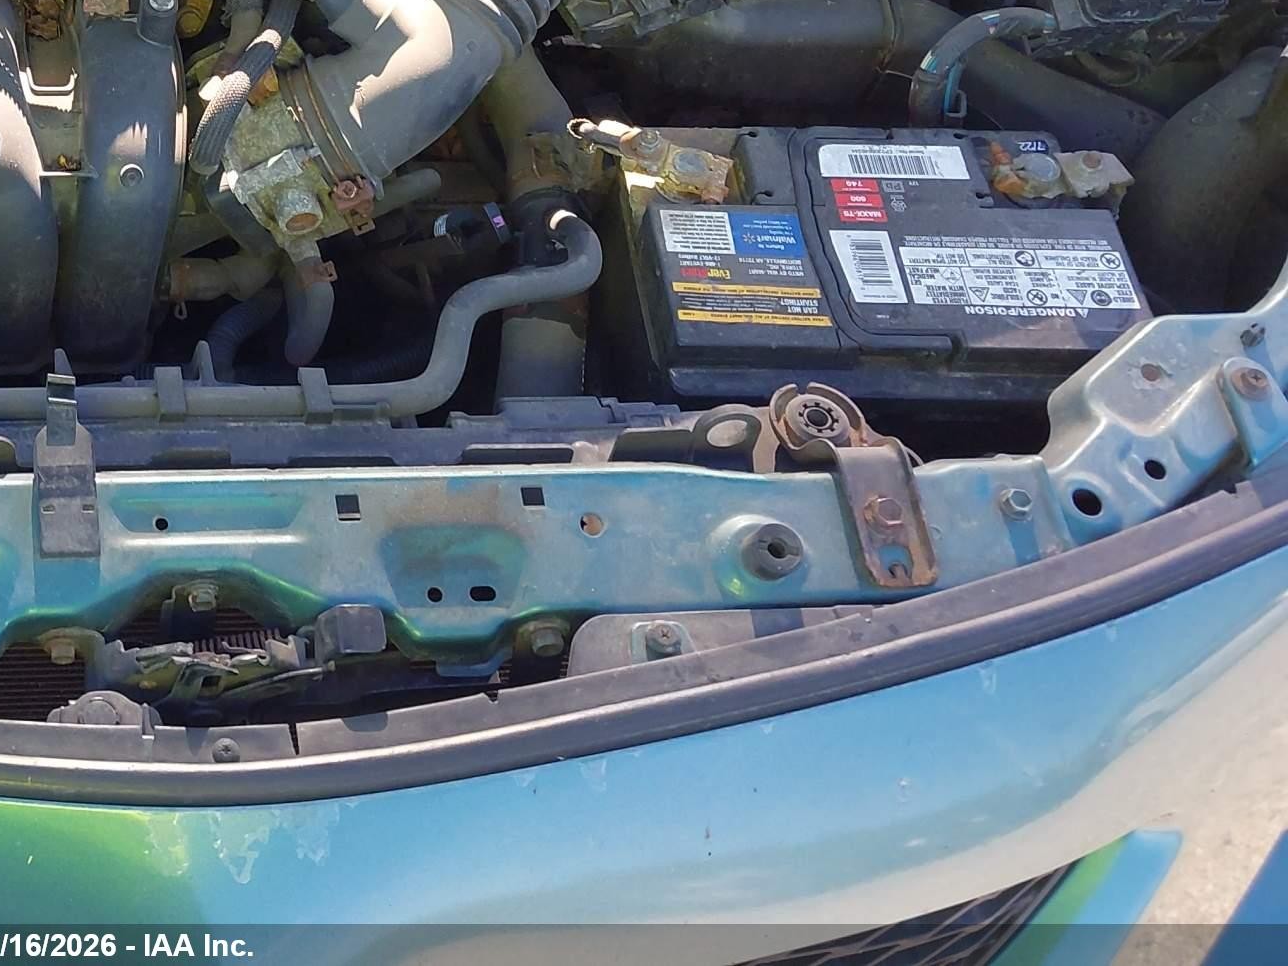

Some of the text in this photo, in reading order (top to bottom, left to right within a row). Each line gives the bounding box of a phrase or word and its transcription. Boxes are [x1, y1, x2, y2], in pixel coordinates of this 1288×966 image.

[756, 235, 796, 244] Walmart
[679, 267, 731, 279] EverStart
[780, 298, 818, 306] STARTING?
[964, 306, 1077, 317] DANGER/POISON
